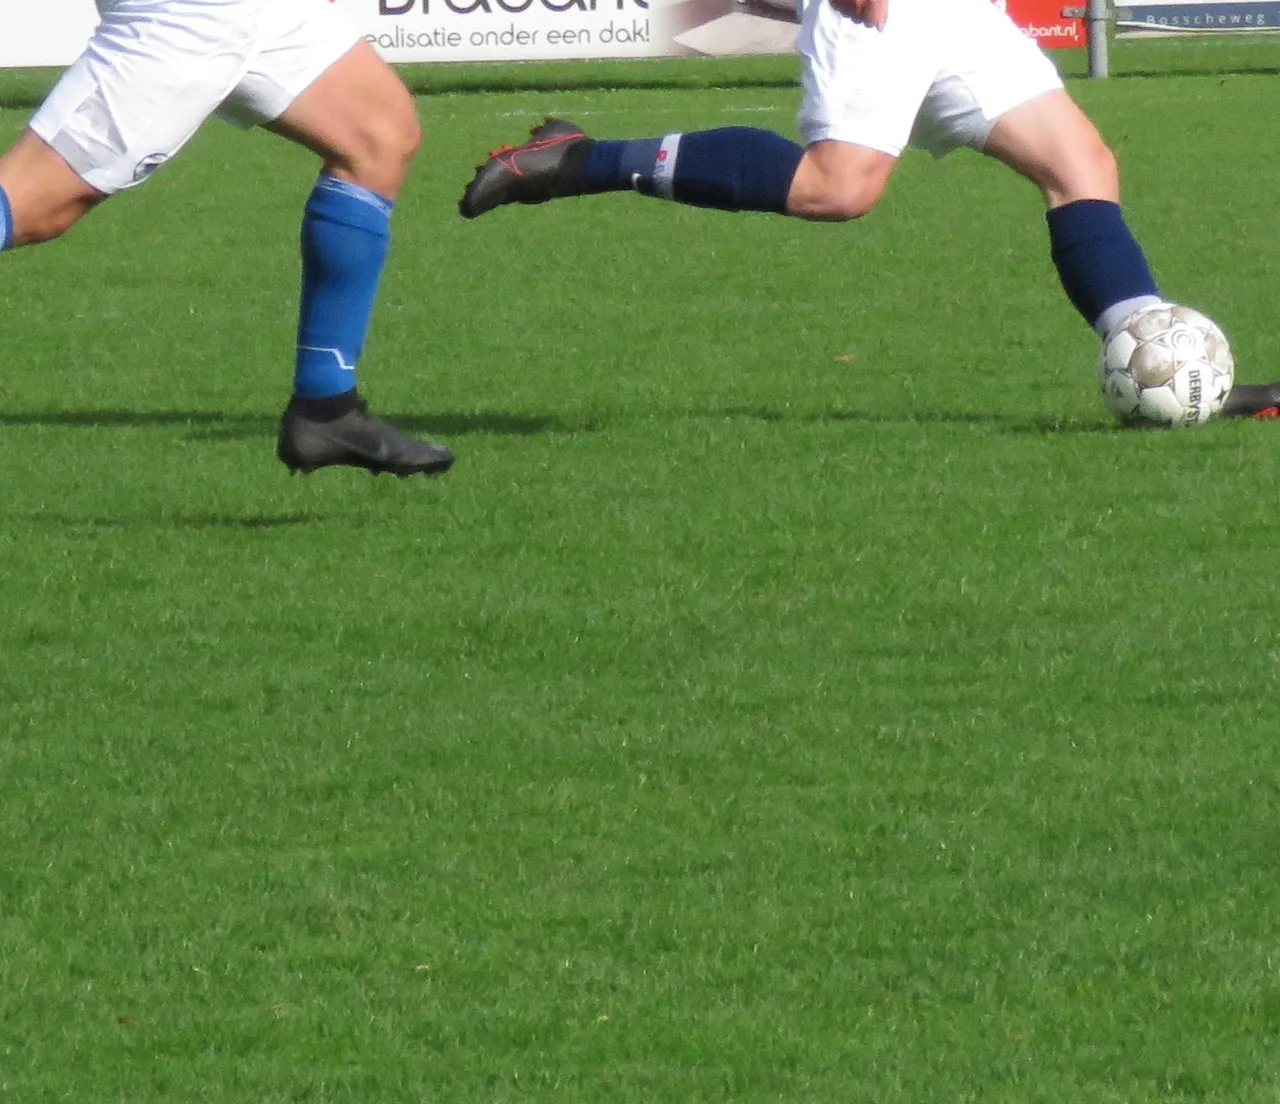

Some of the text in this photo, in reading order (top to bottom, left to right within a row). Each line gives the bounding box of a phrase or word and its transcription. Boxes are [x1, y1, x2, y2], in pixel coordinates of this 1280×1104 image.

[1146, 12, 1266, 27] Bosscheweg
[365, 18, 651, 49] ealisatie onder een dak!
[1020, 20, 1077, 38] abant.nl
